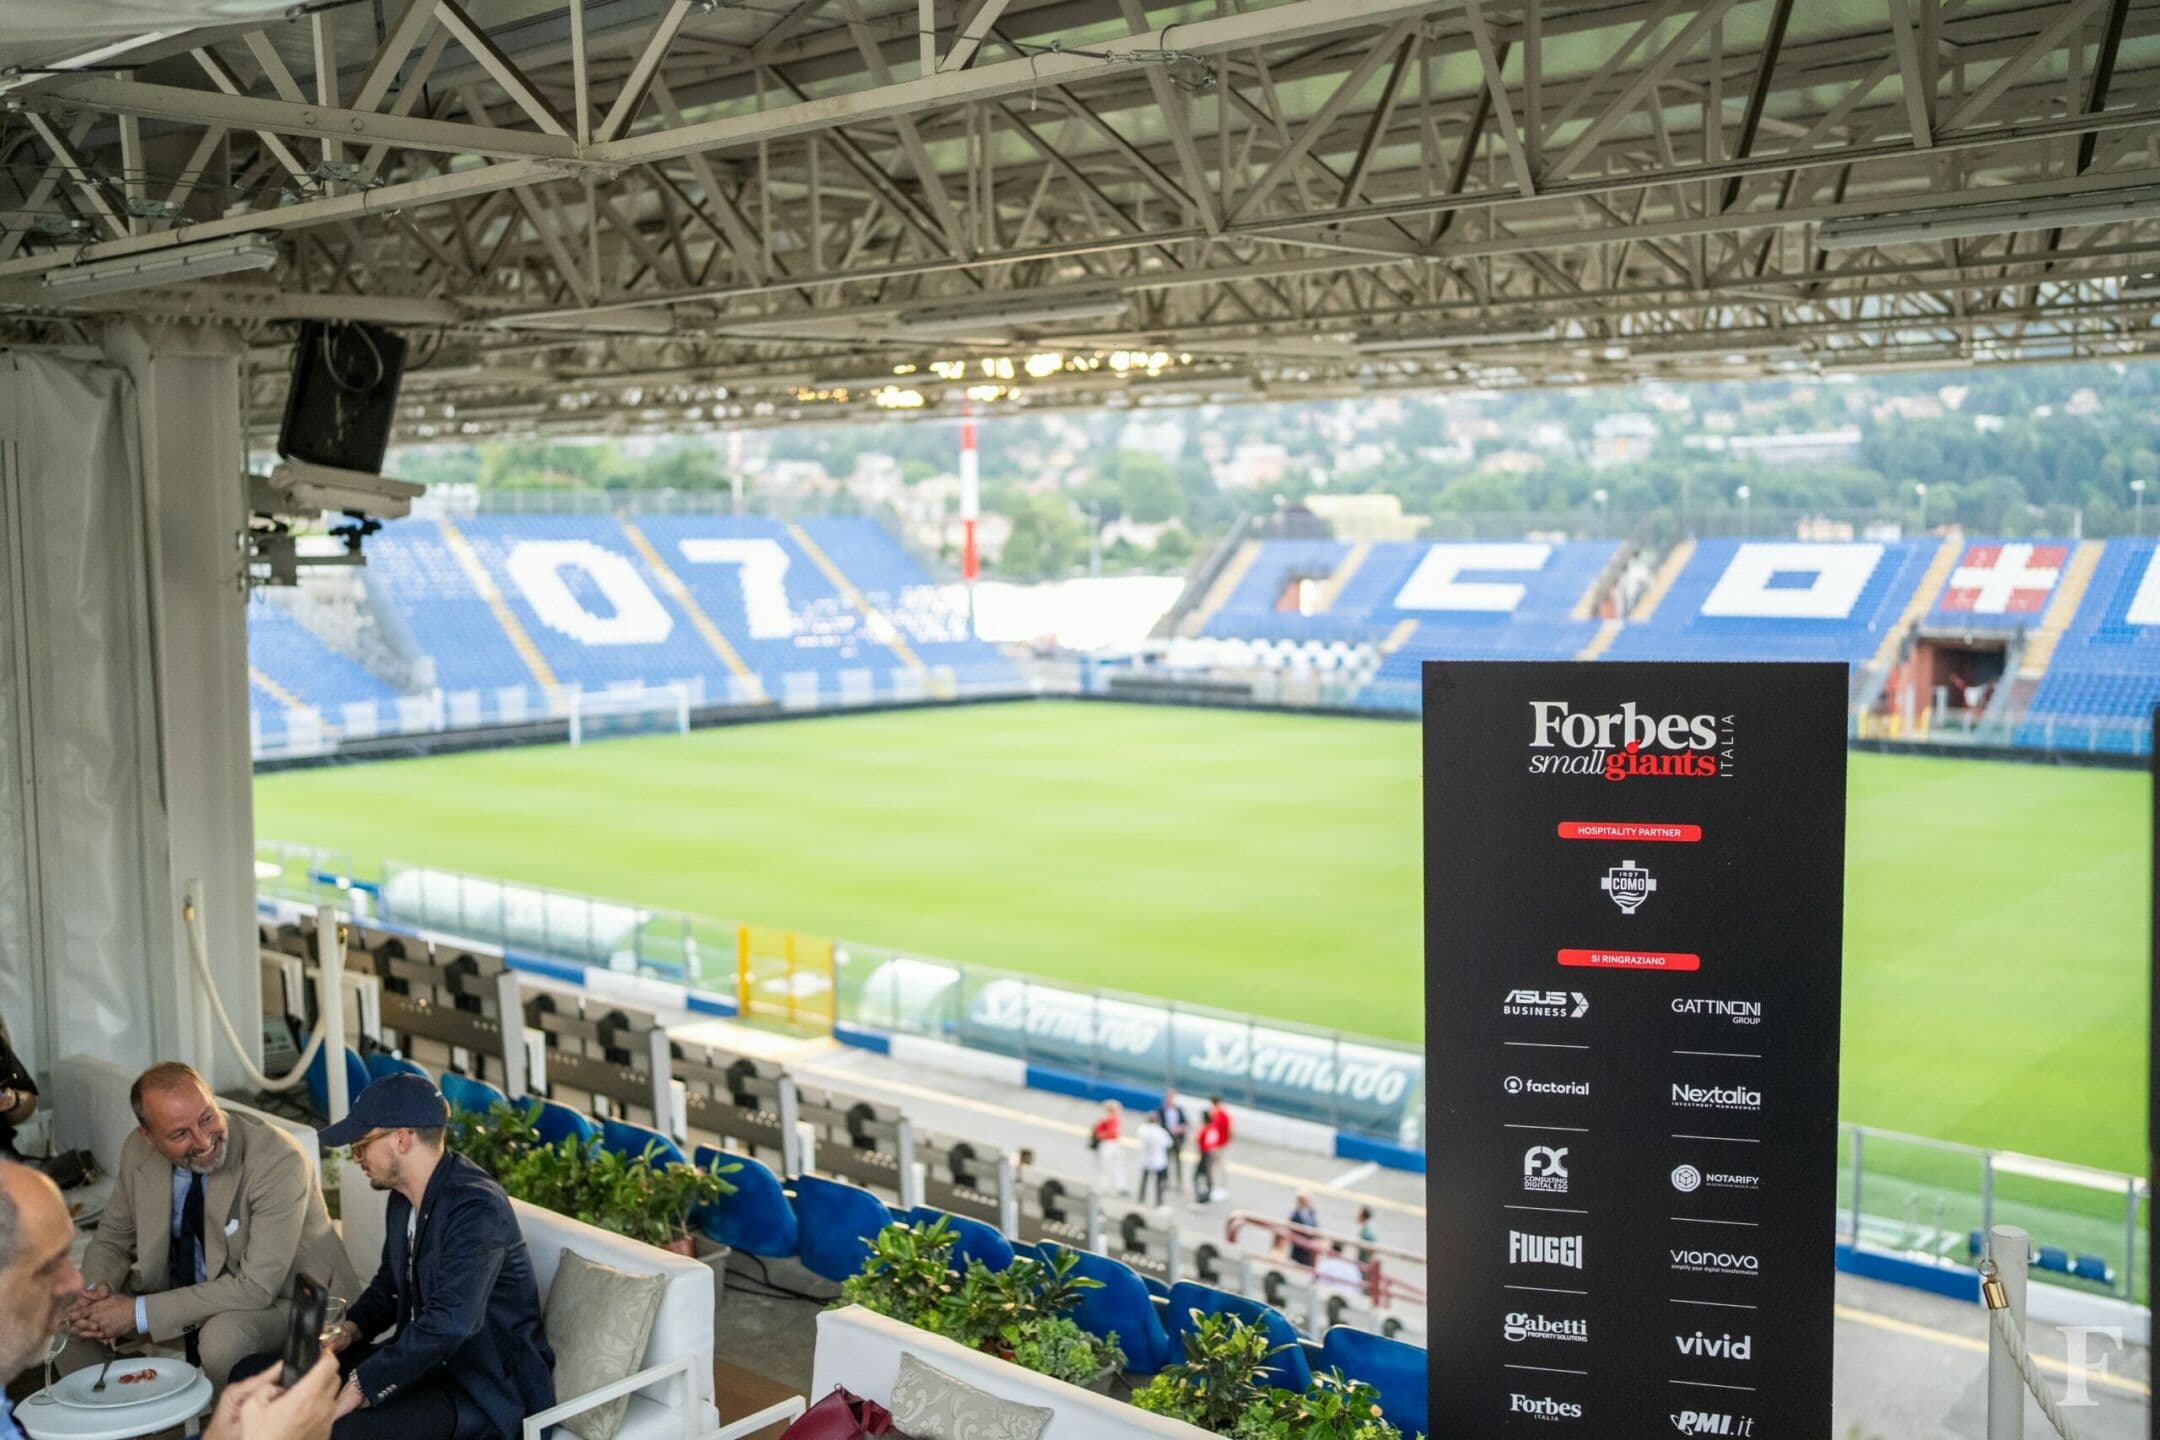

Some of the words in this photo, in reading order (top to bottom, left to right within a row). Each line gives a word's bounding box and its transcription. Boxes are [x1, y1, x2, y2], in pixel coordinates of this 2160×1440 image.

[1528, 701, 1717, 750] Forbes
[1721, 714, 1734, 777] ITALIA
[1529, 748, 1606, 775] small
[1605, 738, 1717, 782] giants
[1578, 827, 1638, 837] HOSPITALITY
[1639, 828, 1681, 838] PARTNER
[1613, 878, 1645, 891] COMO
[1591, 955, 1600, 964] SI
[1602, 955, 1665, 966] RINGRAZIANO
[1504, 990, 1567, 1005] ASUS
[1504, 1004, 1567, 1018] BUSINESS
[1671, 998, 1761, 1017] GATTINONI
[1732, 1016, 1761, 1025] GROUP
[1526, 1078, 1590, 1096] factorial
[1671, 1083, 1761, 1106] Nextalia
[1524, 1145, 1569, 1178] FX
[1524, 1176, 1569, 1184] CONSULTING
[1524, 1181, 1552, 1189] DIGITAL
[1706, 1173, 1760, 1185] NOTARIFY
[1510, 1229, 1583, 1270] FIUGGI
[1670, 1249, 1759, 1270] vianova
[1504, 1312, 1588, 1342] gabetti
[1527, 1331, 1557, 1340] PROPERTY
[1557, 1334, 1588, 1342] SOLUTIONS
[1676, 1331, 1751, 1360] vivid
[1510, 1393, 1582, 1419] Forbes
[1671, 1410, 1754, 1438] PMI.it
